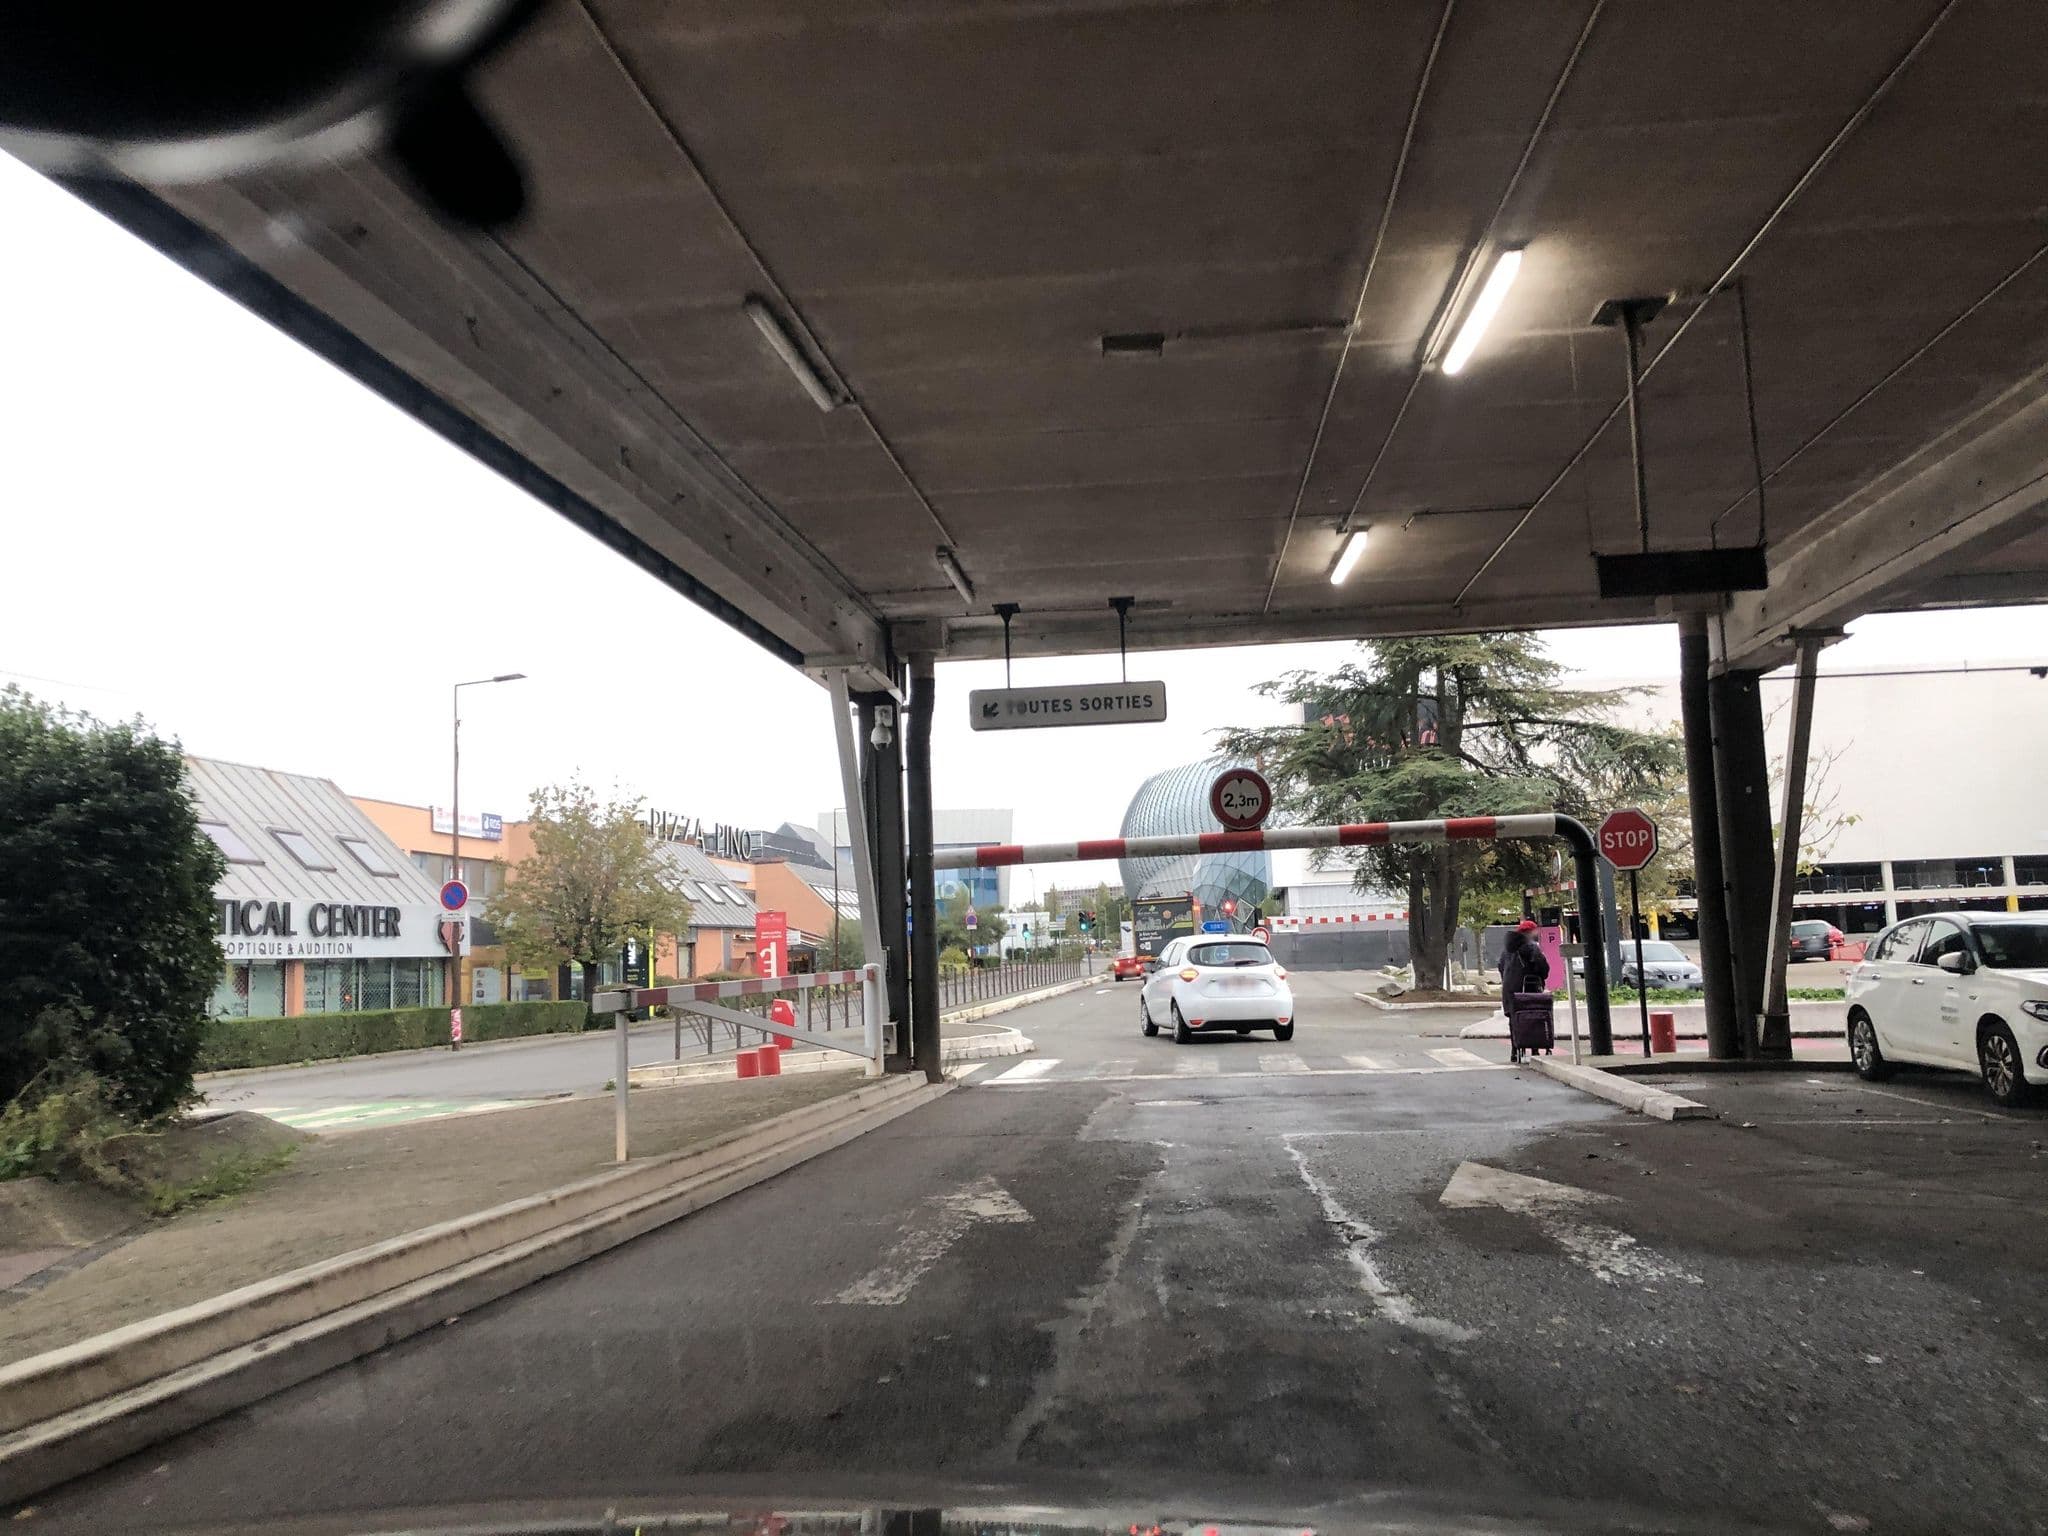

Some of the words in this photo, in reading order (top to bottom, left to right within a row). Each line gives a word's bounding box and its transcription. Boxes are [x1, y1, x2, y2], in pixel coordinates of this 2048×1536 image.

[1080, 695, 1153, 711] SORTIES
[1223, 793, 1260, 809] 2,3m
[651, 808, 706, 854] PIZZA
[715, 822, 752, 860] PINO
[1604, 829, 1649, 849] STOP
[309, 902, 401, 937] CENTER
[227, 942, 282, 955] OPTIQUE
[298, 942, 353, 954] AUDITION
